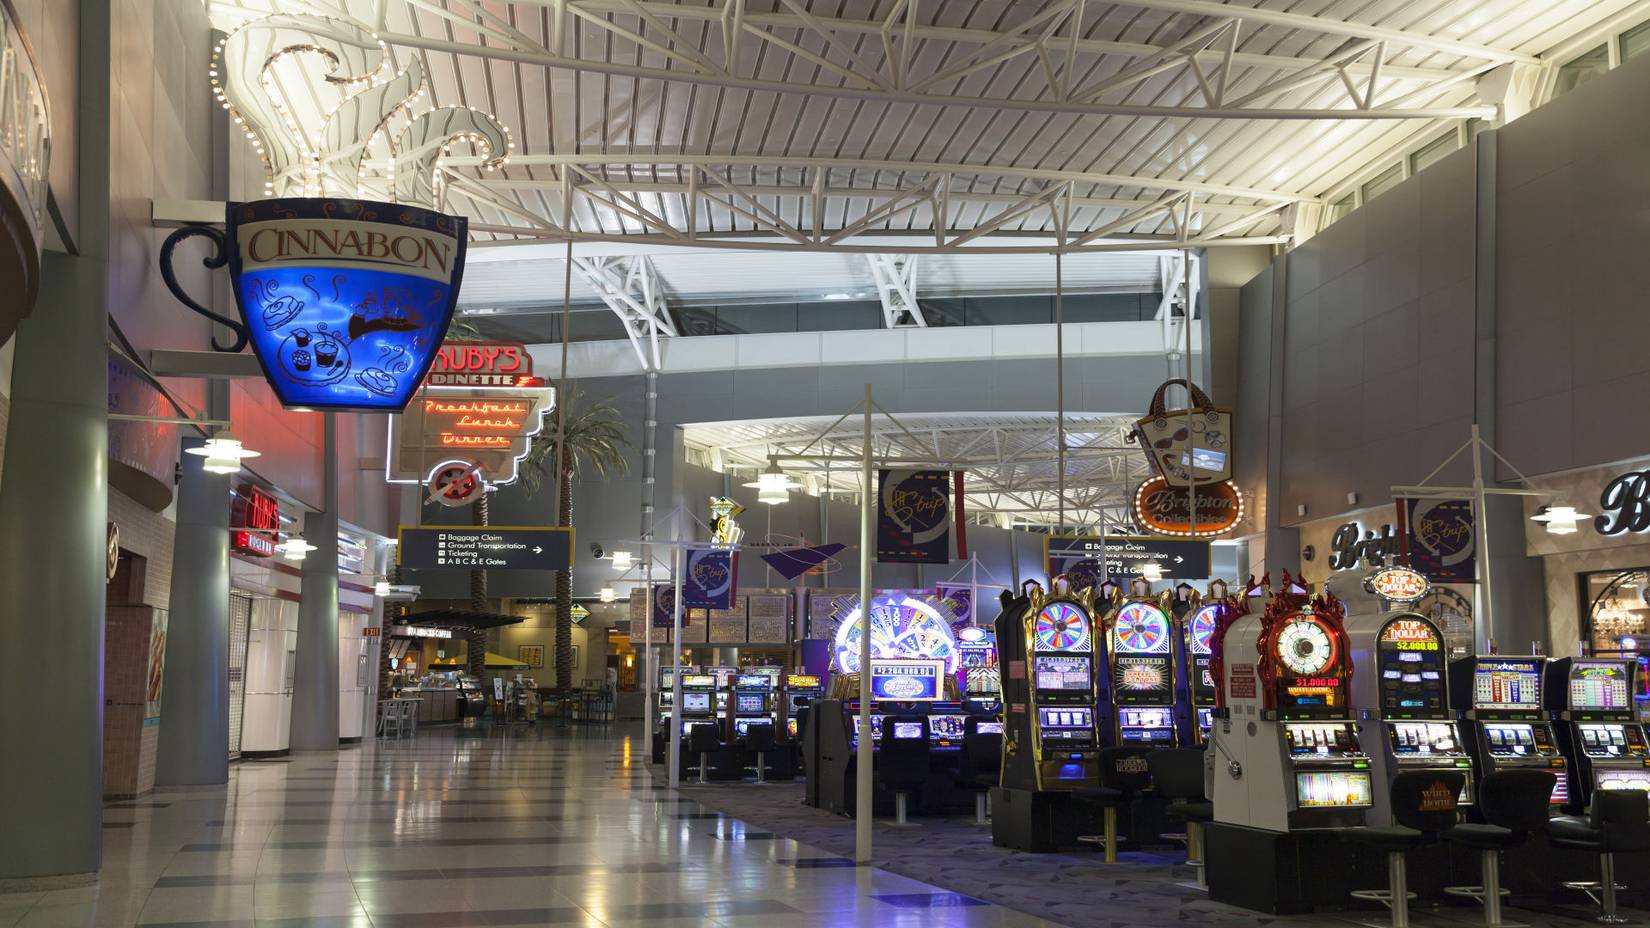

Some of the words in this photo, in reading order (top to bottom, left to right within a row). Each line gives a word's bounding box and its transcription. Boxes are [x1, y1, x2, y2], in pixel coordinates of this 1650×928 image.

[248, 228, 450, 274] CINNABON
[431, 375, 514, 385] DINETTE
[456, 415, 520, 427] Lunch
[441, 432, 511, 444] Dinner
[447, 533, 479, 542] Baggage
[481, 533, 503, 541] Claim
[477, 542, 527, 550] Transportation
[447, 550, 478, 558] Ticketing
[486, 558, 507, 566] Gates
[1389, 575, 1410, 584] TOP
[1382, 583, 1416, 592] DOLLAR
[1398, 621, 1421, 630] TOP
[366, 628, 379, 636] EXIT
[1390, 629, 1429, 640] DOLLAR
[1396, 641, 1439, 651] $2,000.00
[1296, 678, 1339, 686] $1,000.00
